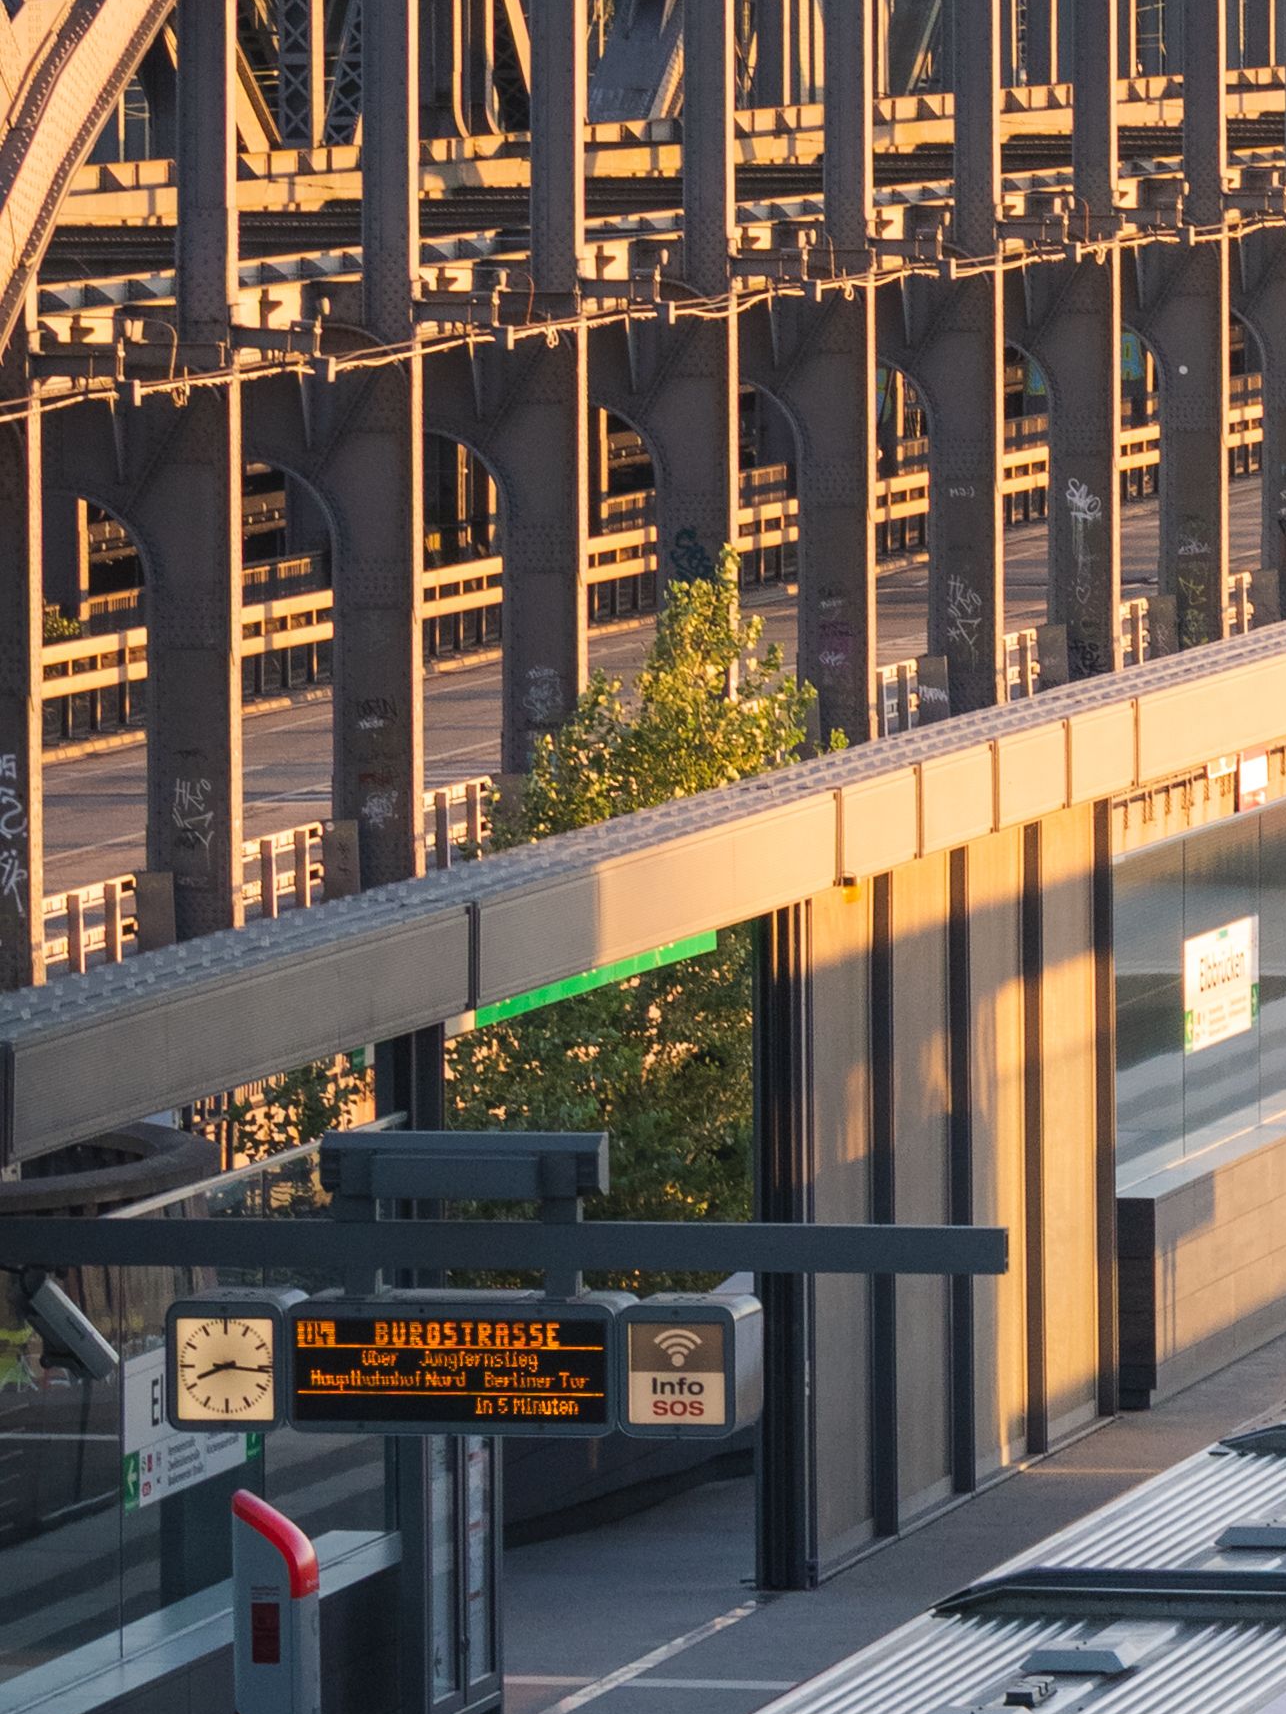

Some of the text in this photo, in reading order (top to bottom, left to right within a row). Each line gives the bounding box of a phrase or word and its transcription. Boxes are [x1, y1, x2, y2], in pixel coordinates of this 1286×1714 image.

[1199, 946, 1246, 993] Elbbrücken
[302, 1320, 561, 1347] U4 BURGSTRASSE
[418, 1350, 539, 1373] Jungfernstieg
[310, 1368, 591, 1391] Hauptbahnhof Nord Berliner Tor
[652, 1377, 705, 1396] Info
[475, 1397, 580, 1416] in 5 Minuten
[652, 1400, 705, 1417] SOS
